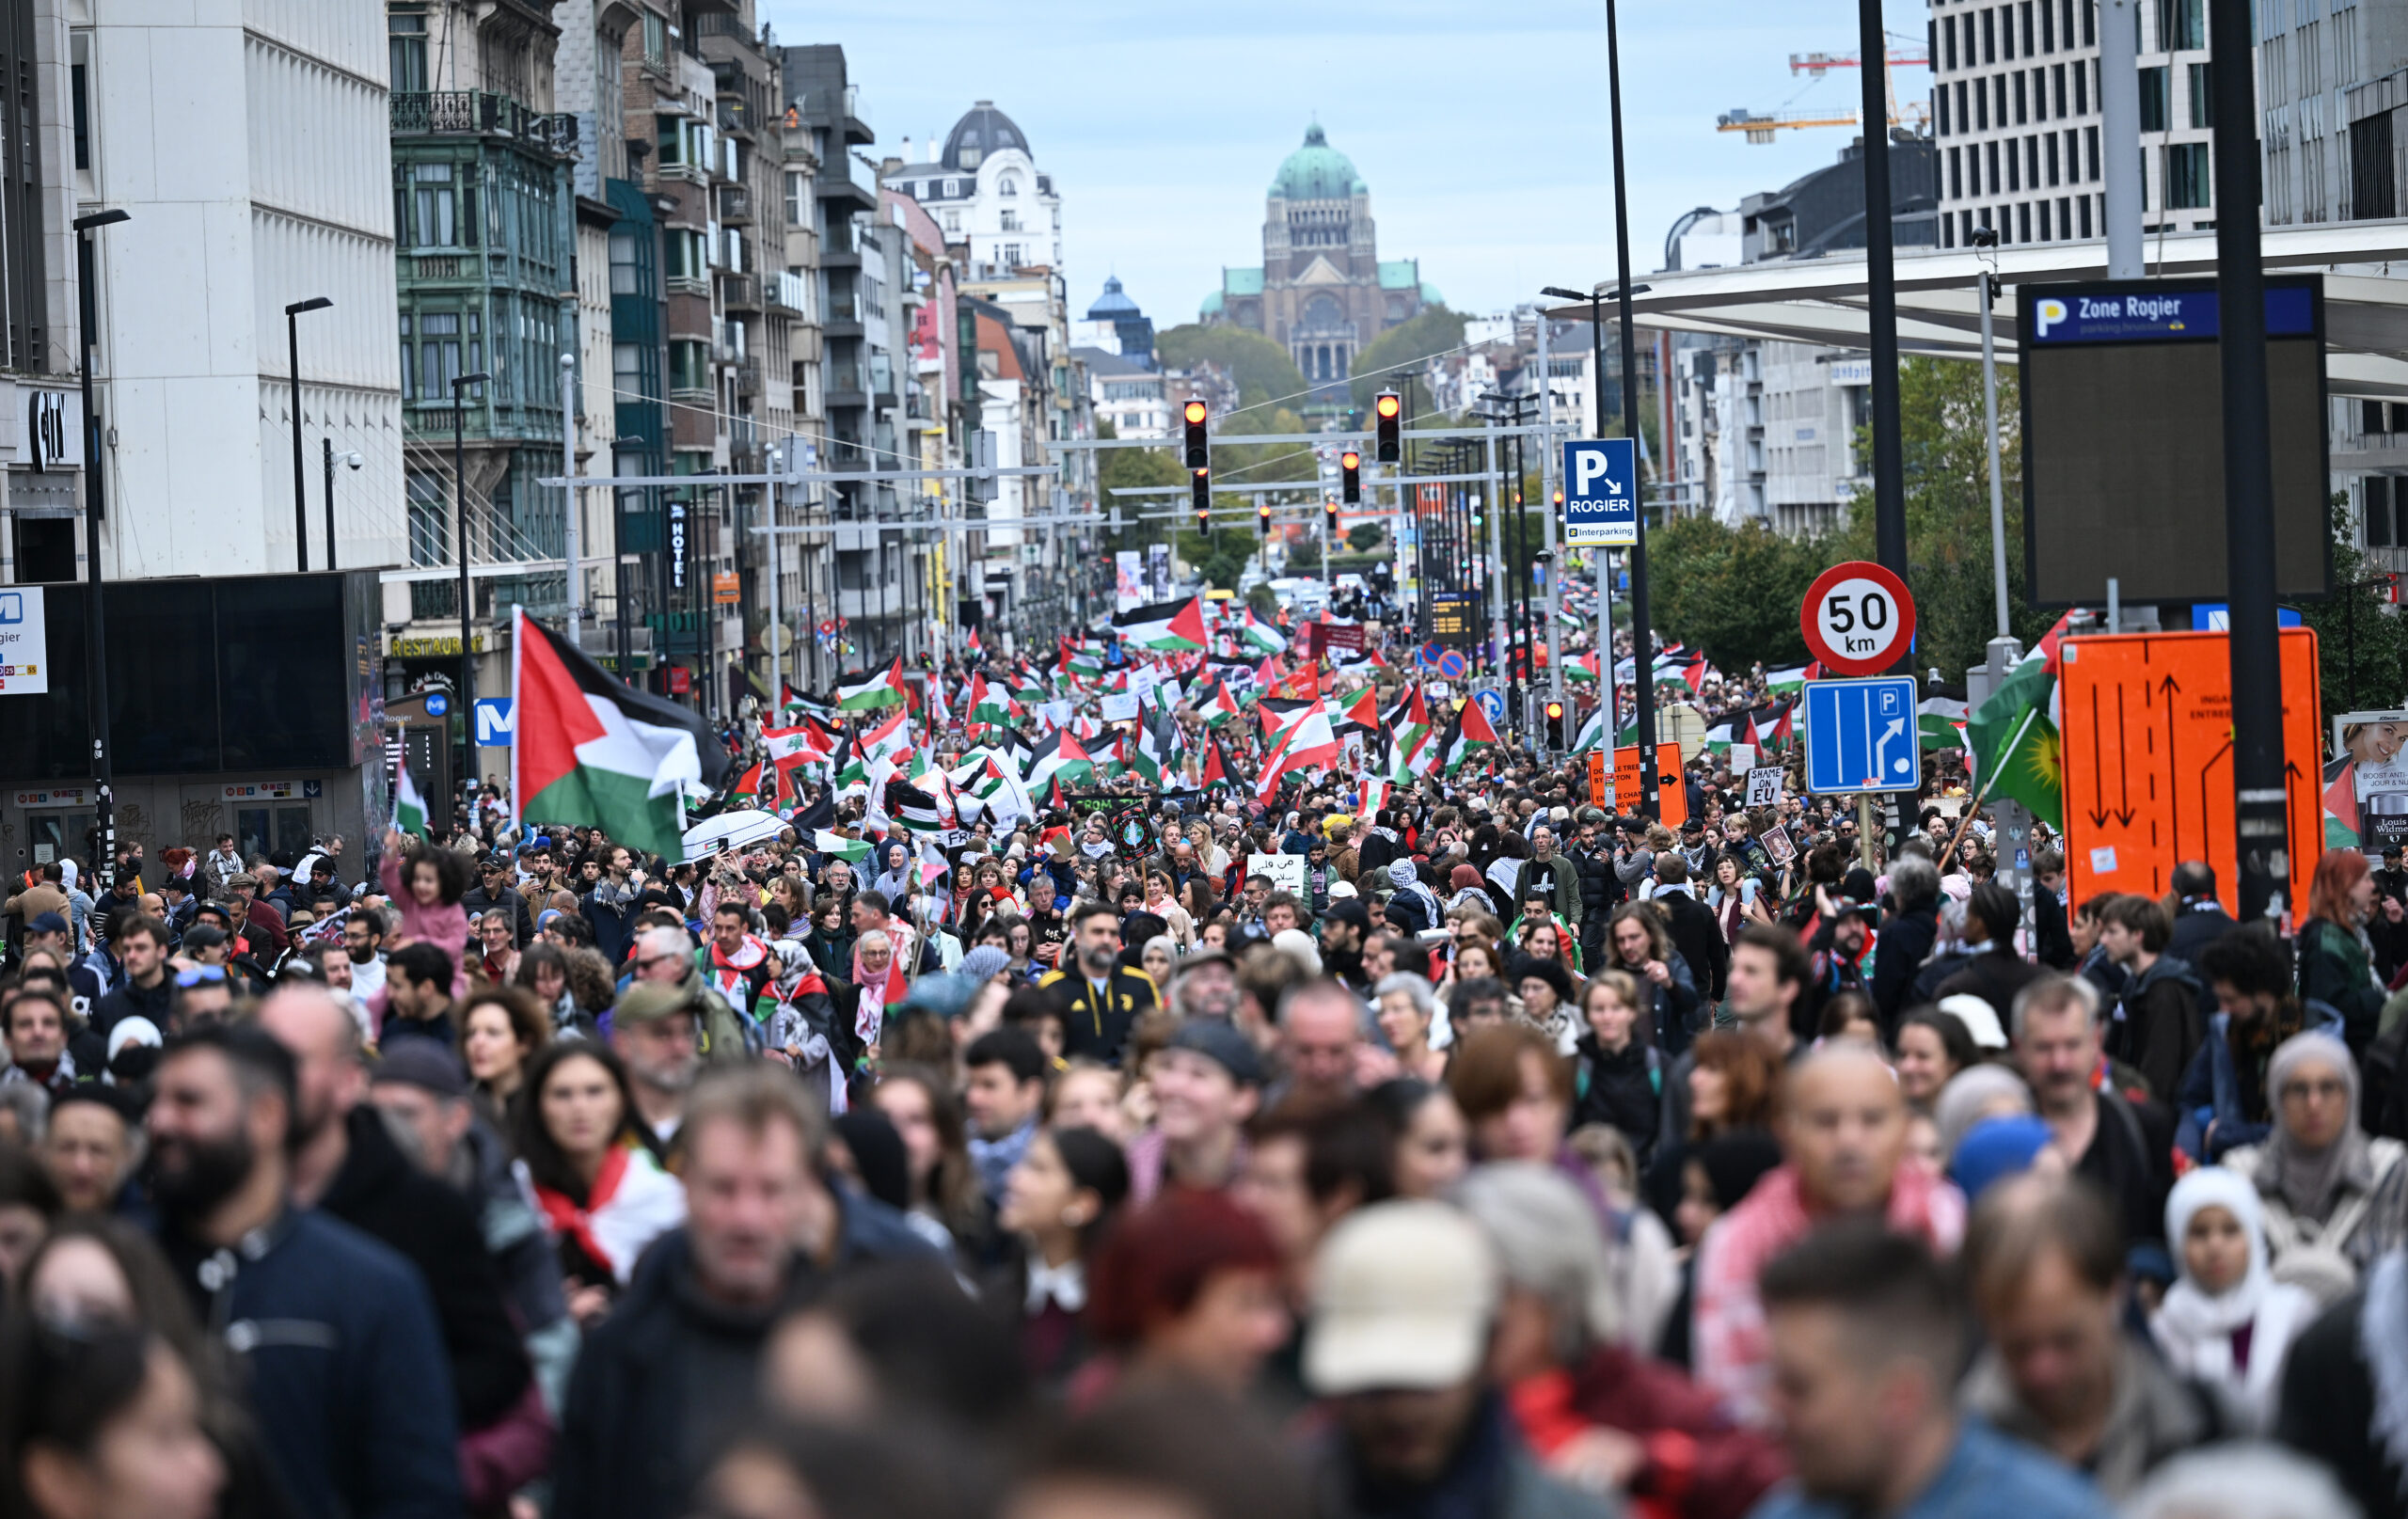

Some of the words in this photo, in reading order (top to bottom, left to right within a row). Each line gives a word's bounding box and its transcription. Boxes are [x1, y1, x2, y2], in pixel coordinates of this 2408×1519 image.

[2079, 297, 2120, 319] Zone
[2126, 295, 2181, 322] Rogier
[1570, 498, 1630, 514] ROGIER
[1579, 527, 1633, 537] Interparking
[672, 522, 685, 588] HOTEL
[1828, 593, 1887, 634] 50
[1845, 636, 1876, 653] km
[1593, 765, 1622, 775] DOLE
[1751, 767, 1781, 779] SHAME
[1759, 779, 1771, 788] ON
[1596, 793, 1623, 802] ENEE
[1753, 787, 1775, 803] EU
[1076, 799, 1113, 811] ROM
[2376, 824, 2408, 833] Widme
